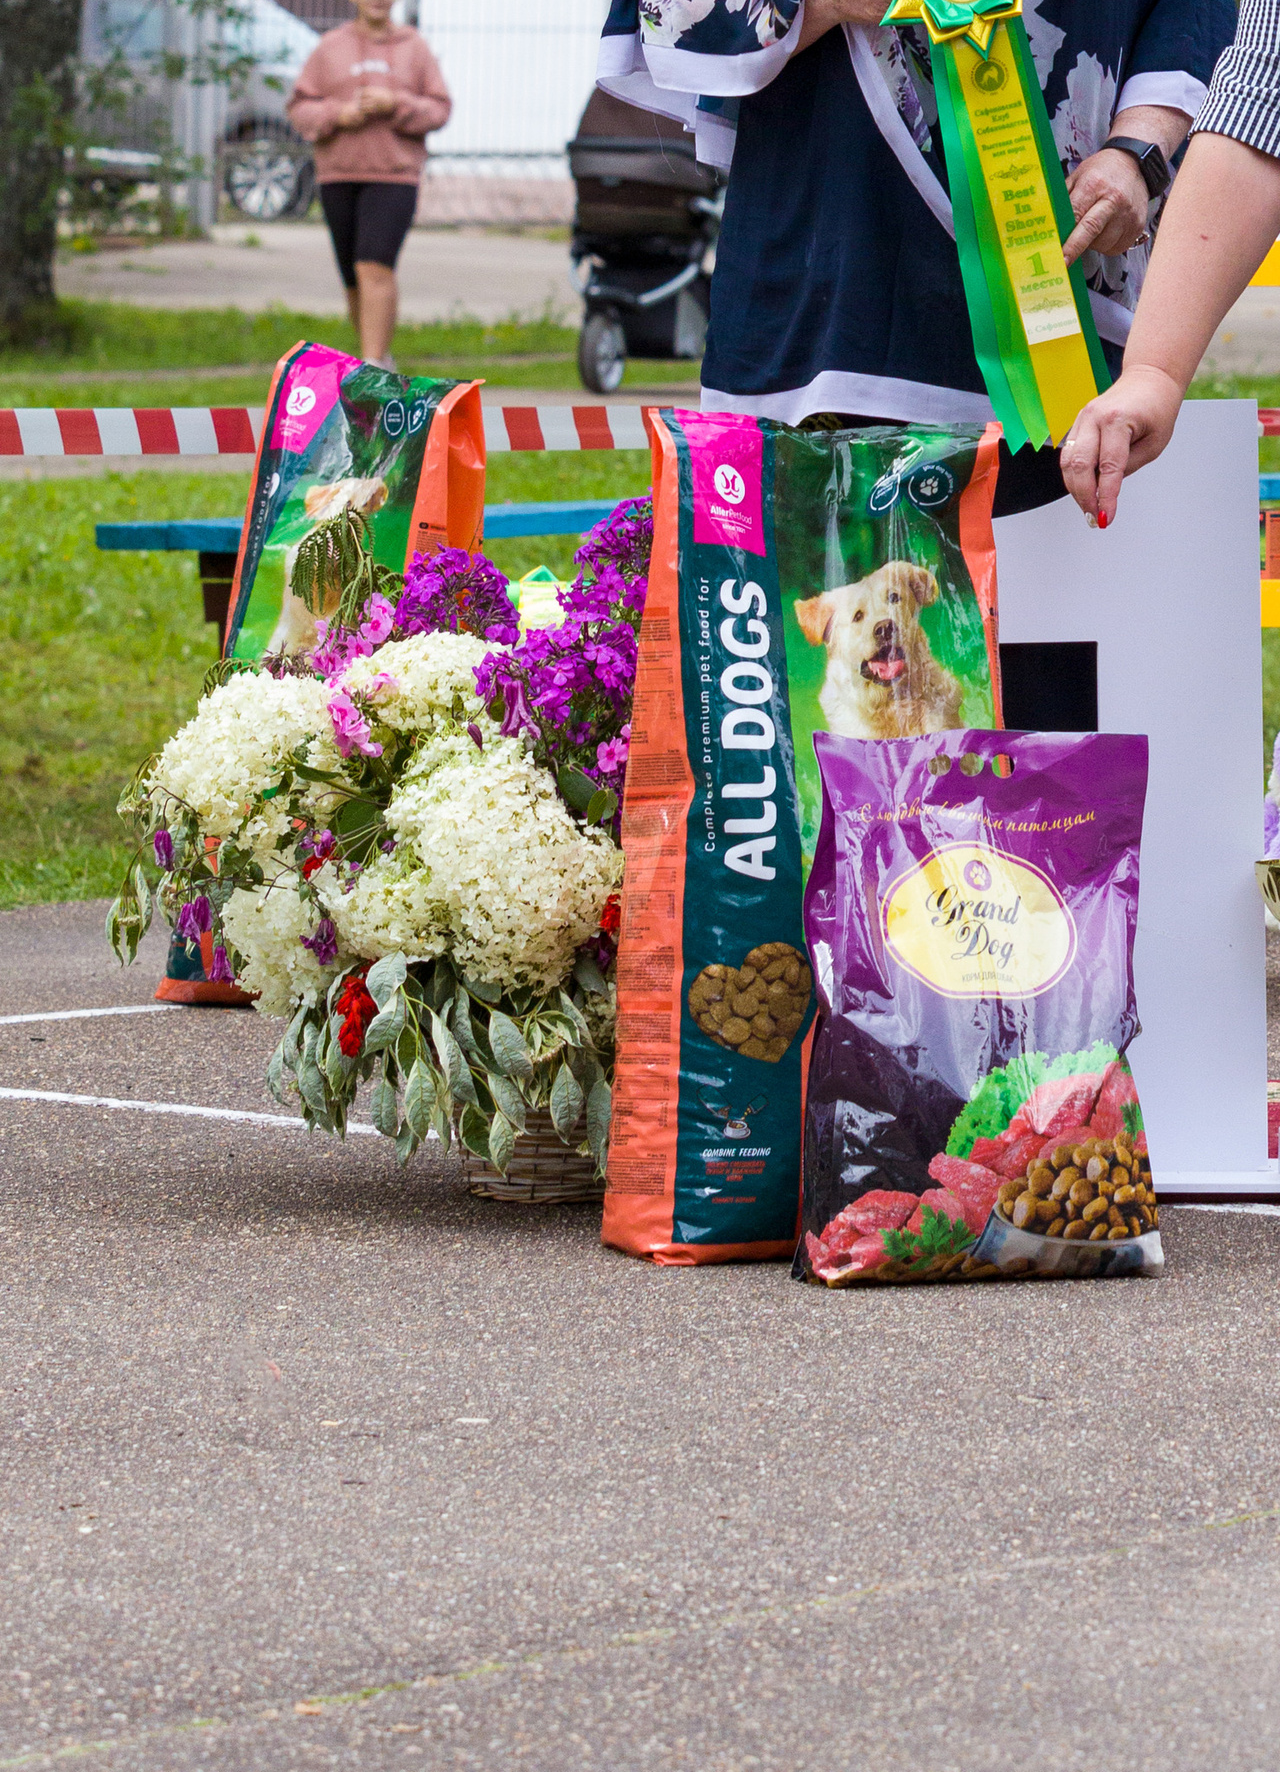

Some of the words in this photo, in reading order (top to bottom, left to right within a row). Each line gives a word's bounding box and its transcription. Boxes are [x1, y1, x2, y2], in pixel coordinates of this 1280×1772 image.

[992, 111, 1010, 123] Клуб
[1002, 185, 1036, 202] Best
[1014, 203, 1032, 215] In
[1005, 214, 1047, 233] Show
[1005, 228, 1055, 249] Junior
[1026, 251, 1049, 278] 1
[1020, 276, 1064, 294] место
[256, 500, 266, 529] food
[262, 475, 271, 494] for
[711, 505, 752, 525] AllerPetfood
[698, 577, 710, 604] for
[698, 610, 710, 648] food
[700, 654, 713, 683] pet
[719, 578, 776, 751] DOGS
[700, 690, 714, 764] premium
[704, 772, 716, 853] Complete
[721, 765, 777, 881] ALL
[860, 803, 876, 824] С
[876, 796, 934, 823] любовью
[948, 801, 1003, 830] вашим
[1006, 809, 1096, 833] питомцам
[925, 884, 1022, 927] Grand
[950, 919, 1015, 970] Dog
[962, 972, 981, 983] КОРМ
[702, 1148, 736, 1157] COMBINE
[739, 1147, 771, 1157] FEEDING
